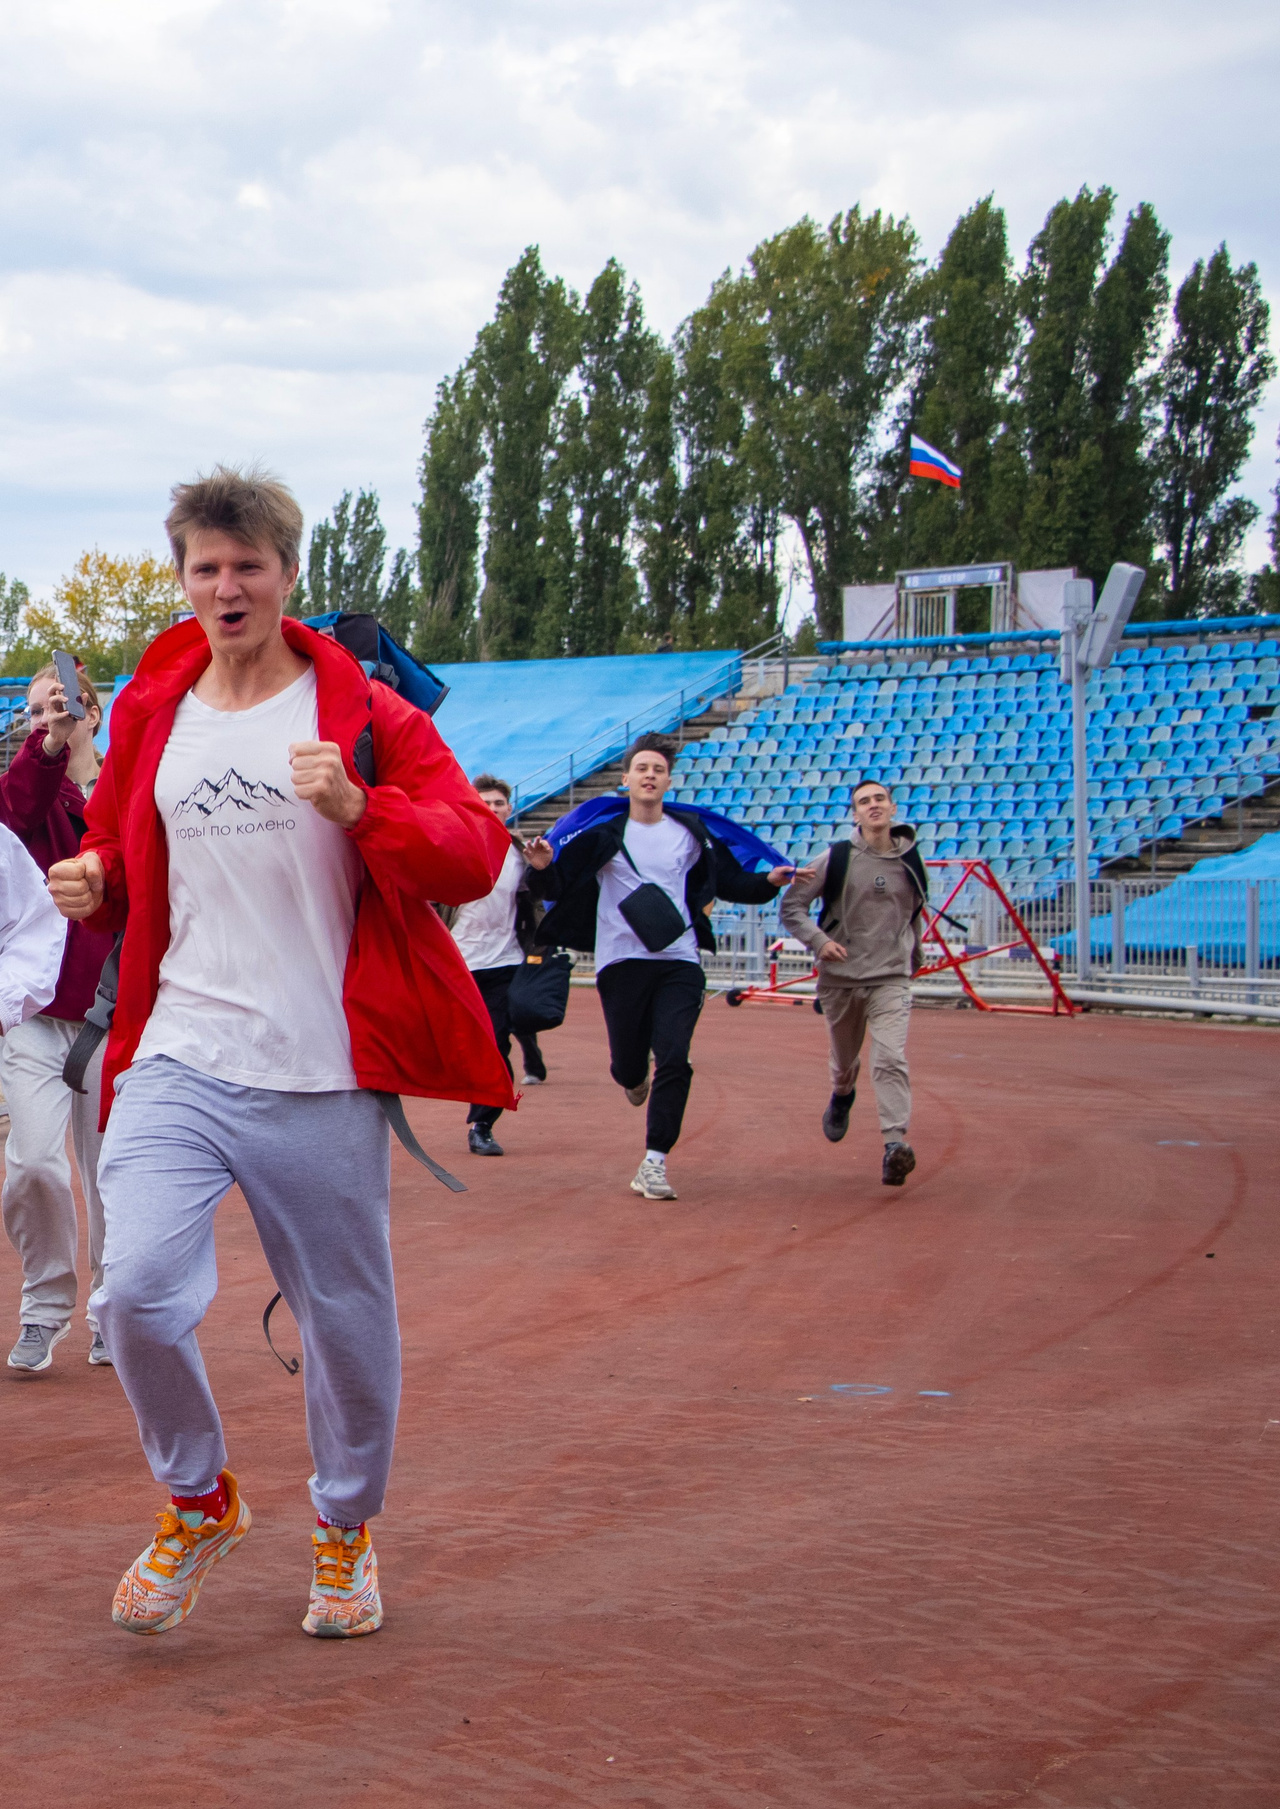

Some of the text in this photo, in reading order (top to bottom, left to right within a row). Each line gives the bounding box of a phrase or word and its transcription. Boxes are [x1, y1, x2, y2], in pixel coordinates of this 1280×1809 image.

[176, 819, 296, 841] горы по колено
